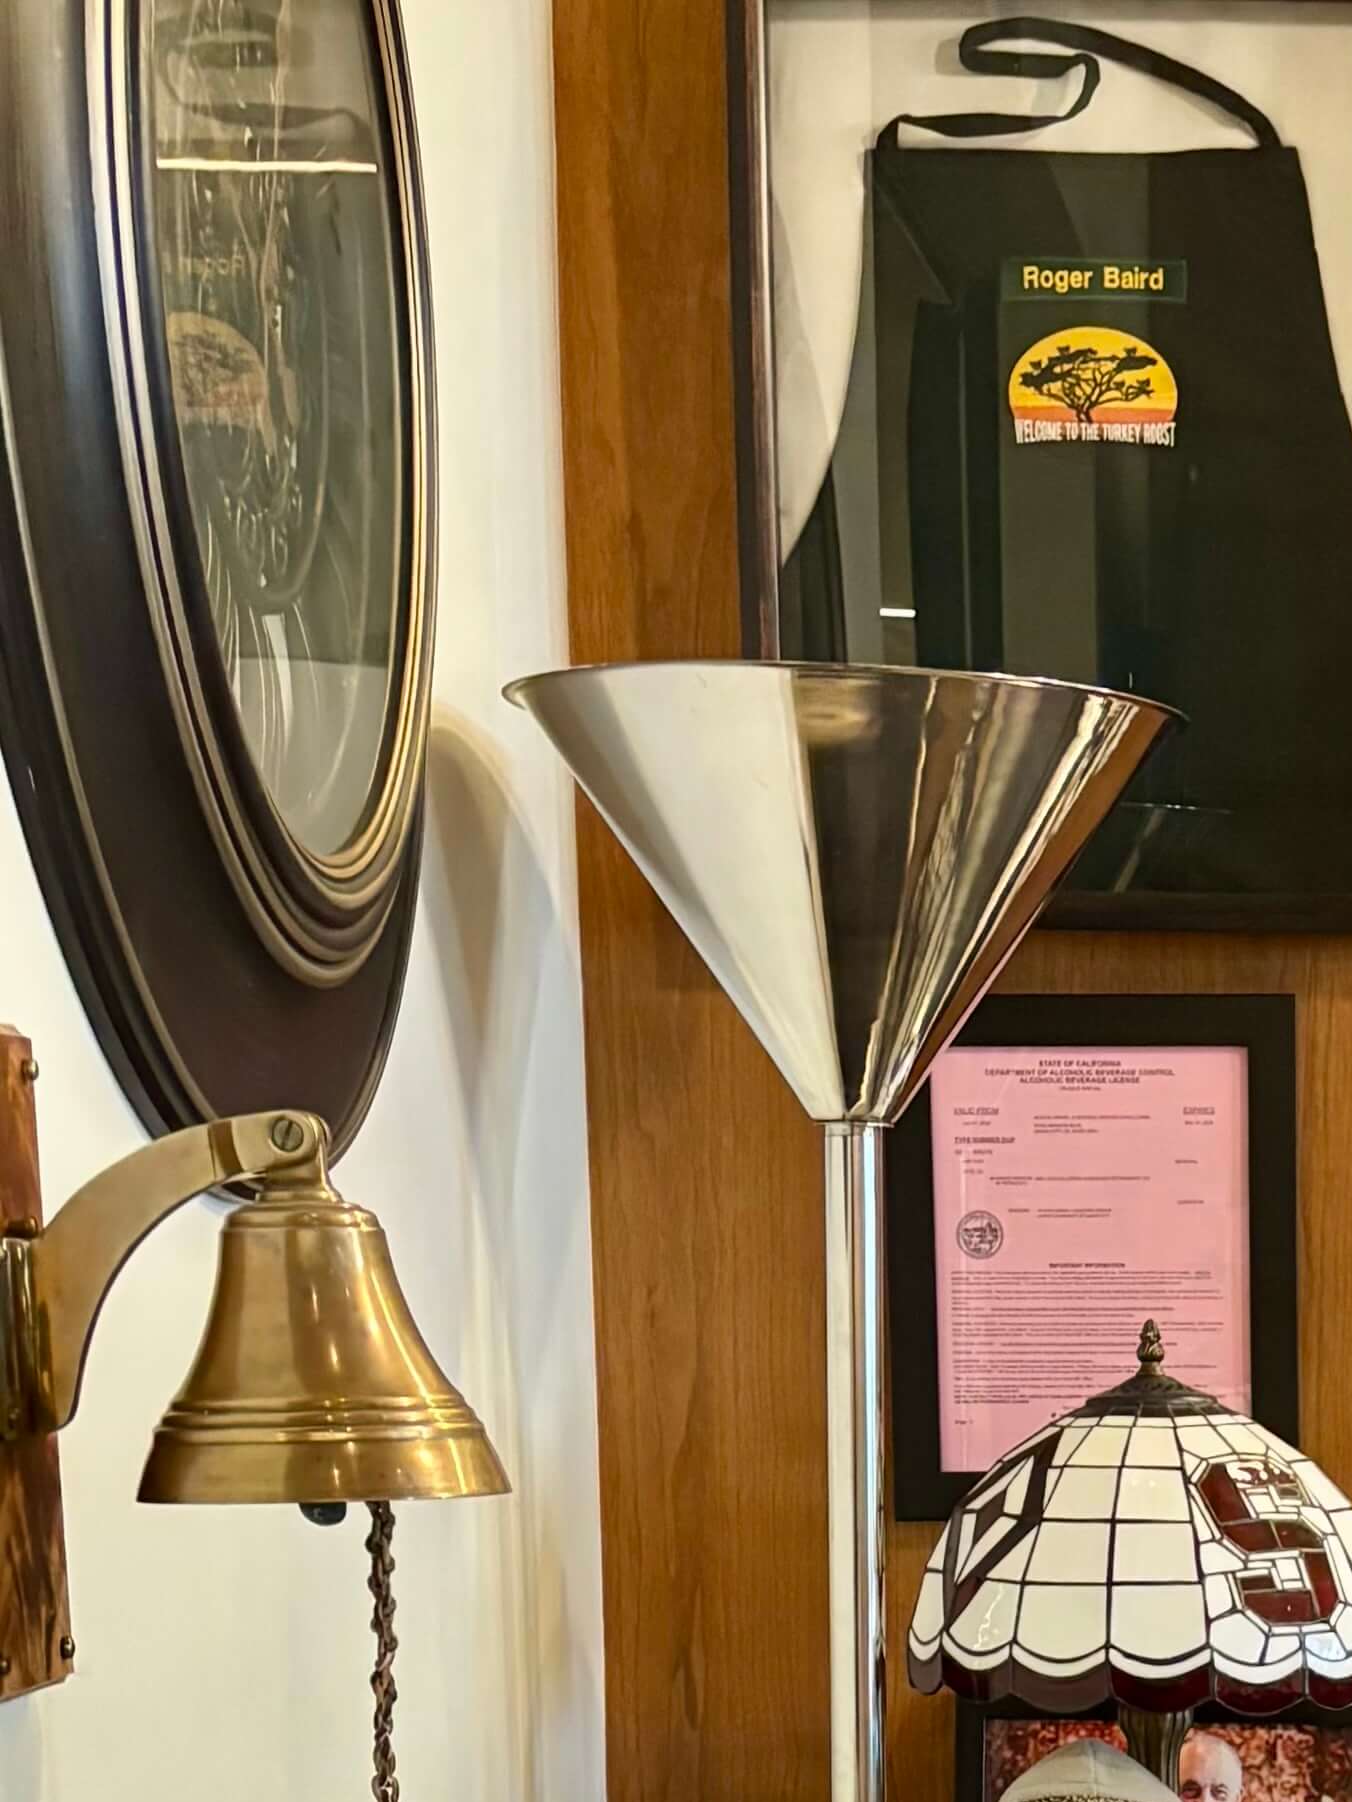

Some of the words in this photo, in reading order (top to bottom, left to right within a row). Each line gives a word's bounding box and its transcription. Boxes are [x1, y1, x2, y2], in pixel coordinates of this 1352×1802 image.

[1023, 265, 1093, 293] Roger
[1103, 266, 1164, 290] Baird
[1014, 418, 1062, 444] WELCOME
[1065, 421, 1079, 440] TO
[1080, 421, 1100, 441] THE
[1103, 422, 1141, 444] TURKEY
[1143, 422, 1176, 447] ROOST
